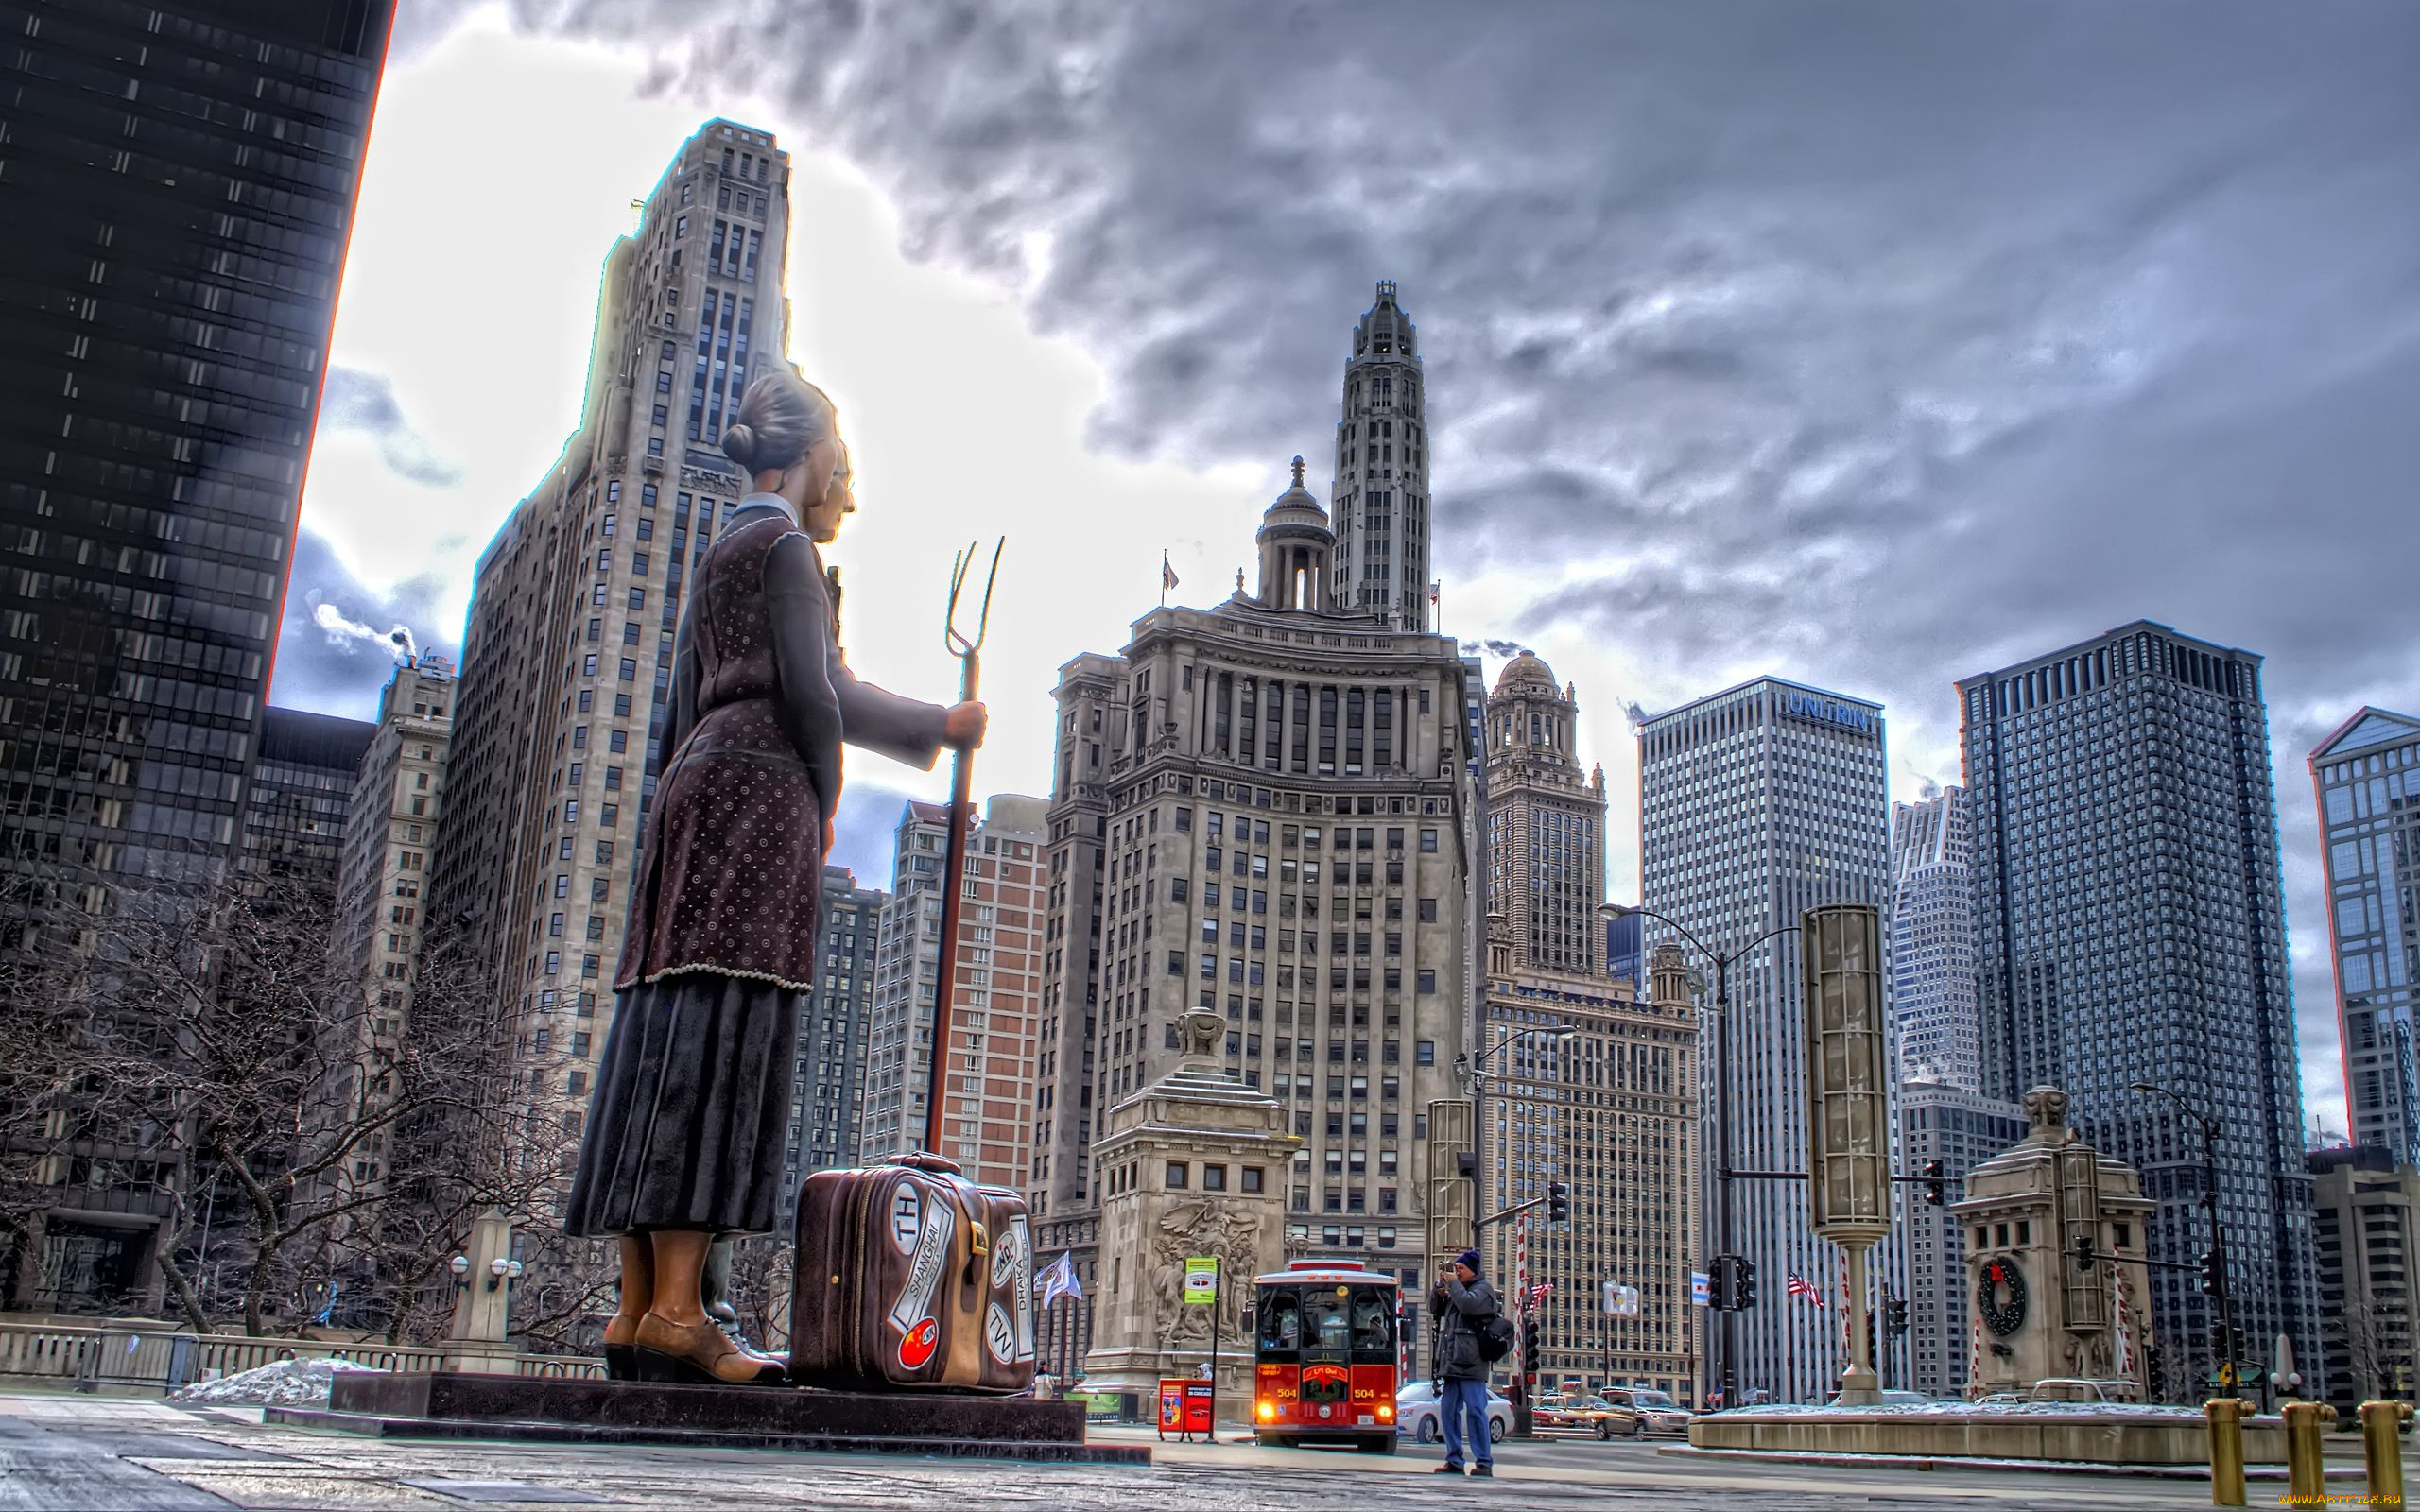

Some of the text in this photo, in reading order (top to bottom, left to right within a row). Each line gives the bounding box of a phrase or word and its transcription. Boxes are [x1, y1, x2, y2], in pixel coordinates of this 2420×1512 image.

[1789, 692, 1868, 731] UNITRIN
[896, 1196, 916, 1241] TH
[909, 1224, 939, 1297] SHANGHAI
[925, 1254, 941, 1286] CHINA
[1015, 1259, 1027, 1311] DHAKA
[989, 1308, 1012, 1354] TW
[1277, 1388, 1297, 1398] 504
[1354, 1389, 1374, 1399] 504
